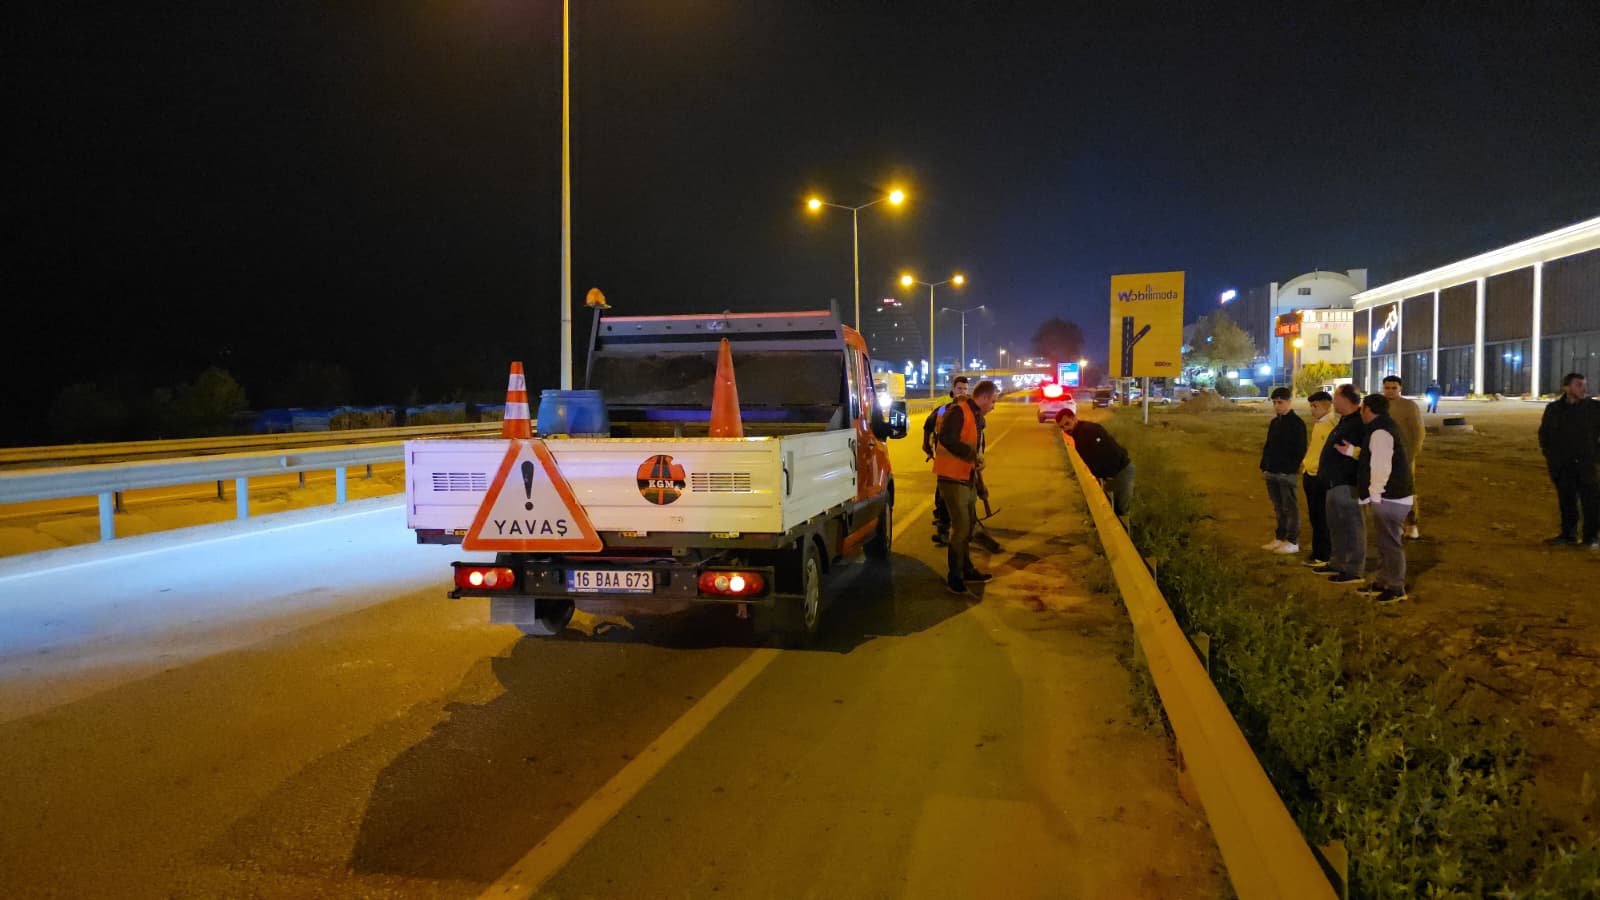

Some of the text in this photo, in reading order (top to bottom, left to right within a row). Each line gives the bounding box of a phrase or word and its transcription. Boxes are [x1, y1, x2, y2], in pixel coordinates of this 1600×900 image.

[648, 479, 674, 489] KGM
[494, 519, 568, 537] YAVAŞ
[576, 572, 590, 587] 16
[596, 572, 620, 587] BAA
[625, 572, 650, 588] 673
